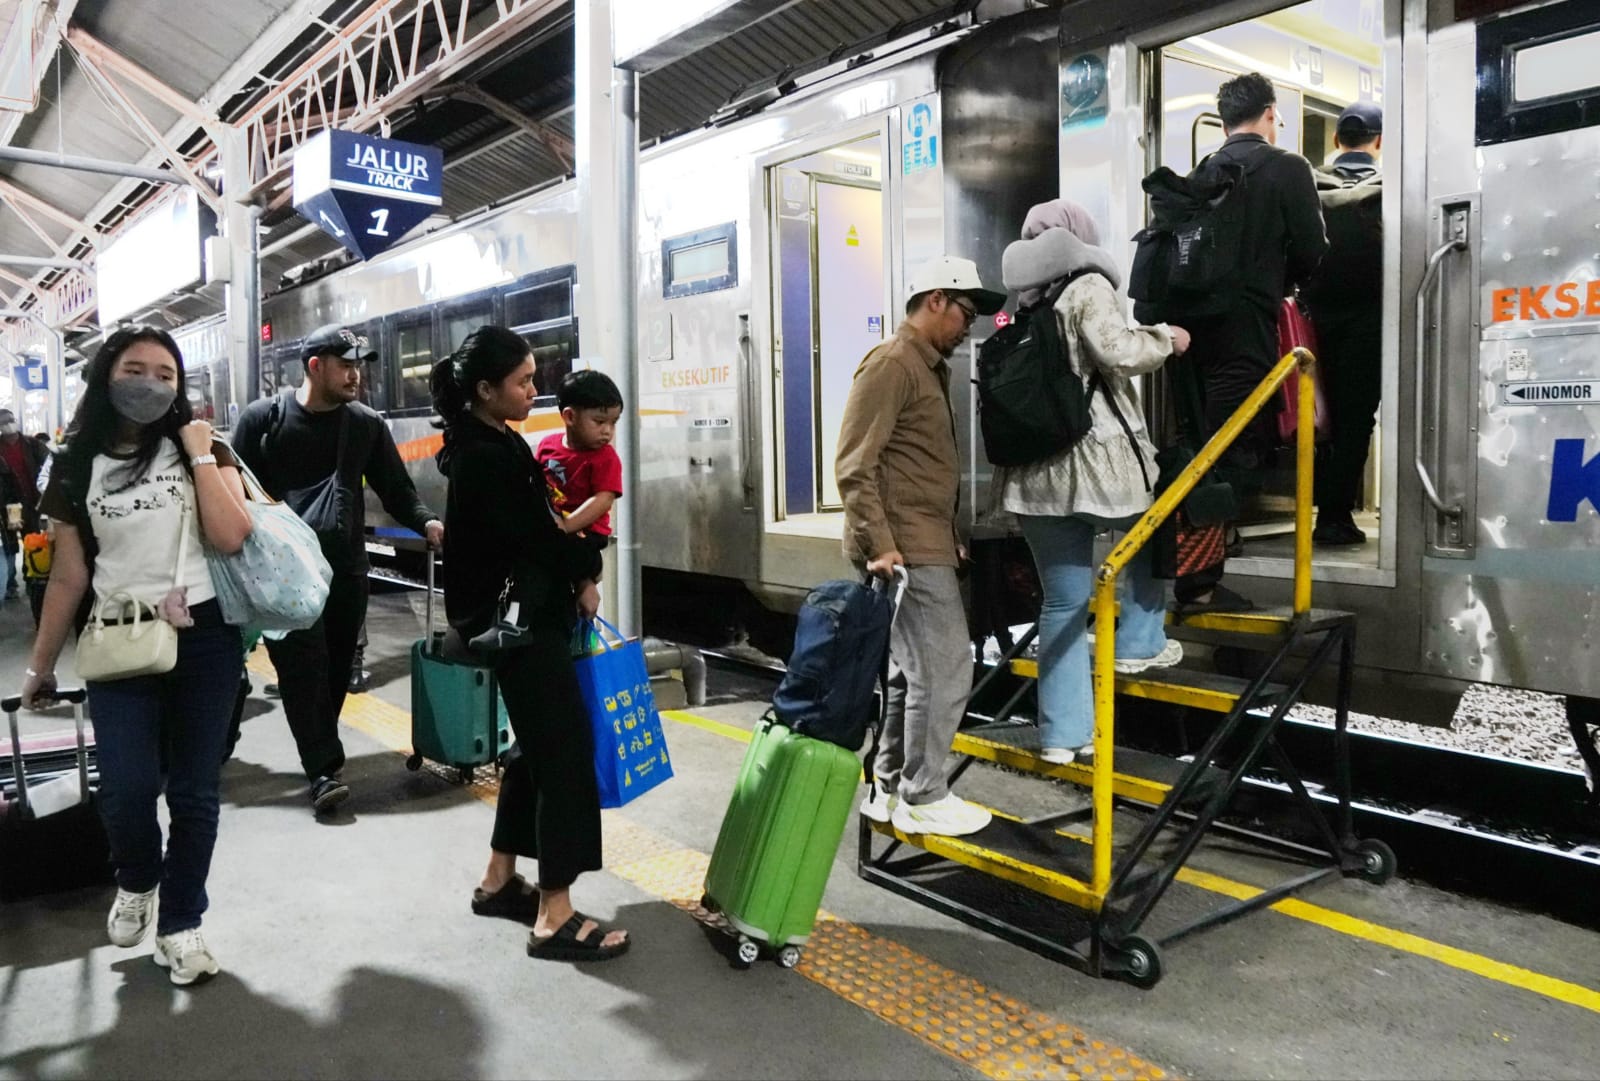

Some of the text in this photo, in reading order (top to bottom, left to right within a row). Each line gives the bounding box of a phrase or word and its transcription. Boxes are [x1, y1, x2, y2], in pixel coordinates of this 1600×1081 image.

[346, 143, 429, 178] JALUR
[367, 170, 414, 190] TRACK
[319, 210, 346, 237] 1
[367, 208, 389, 236] 1
[661, 366, 730, 388] EKSEKUTIF
[1541, 385, 1591, 400] NOMOR
[1547, 439, 1600, 522] K
